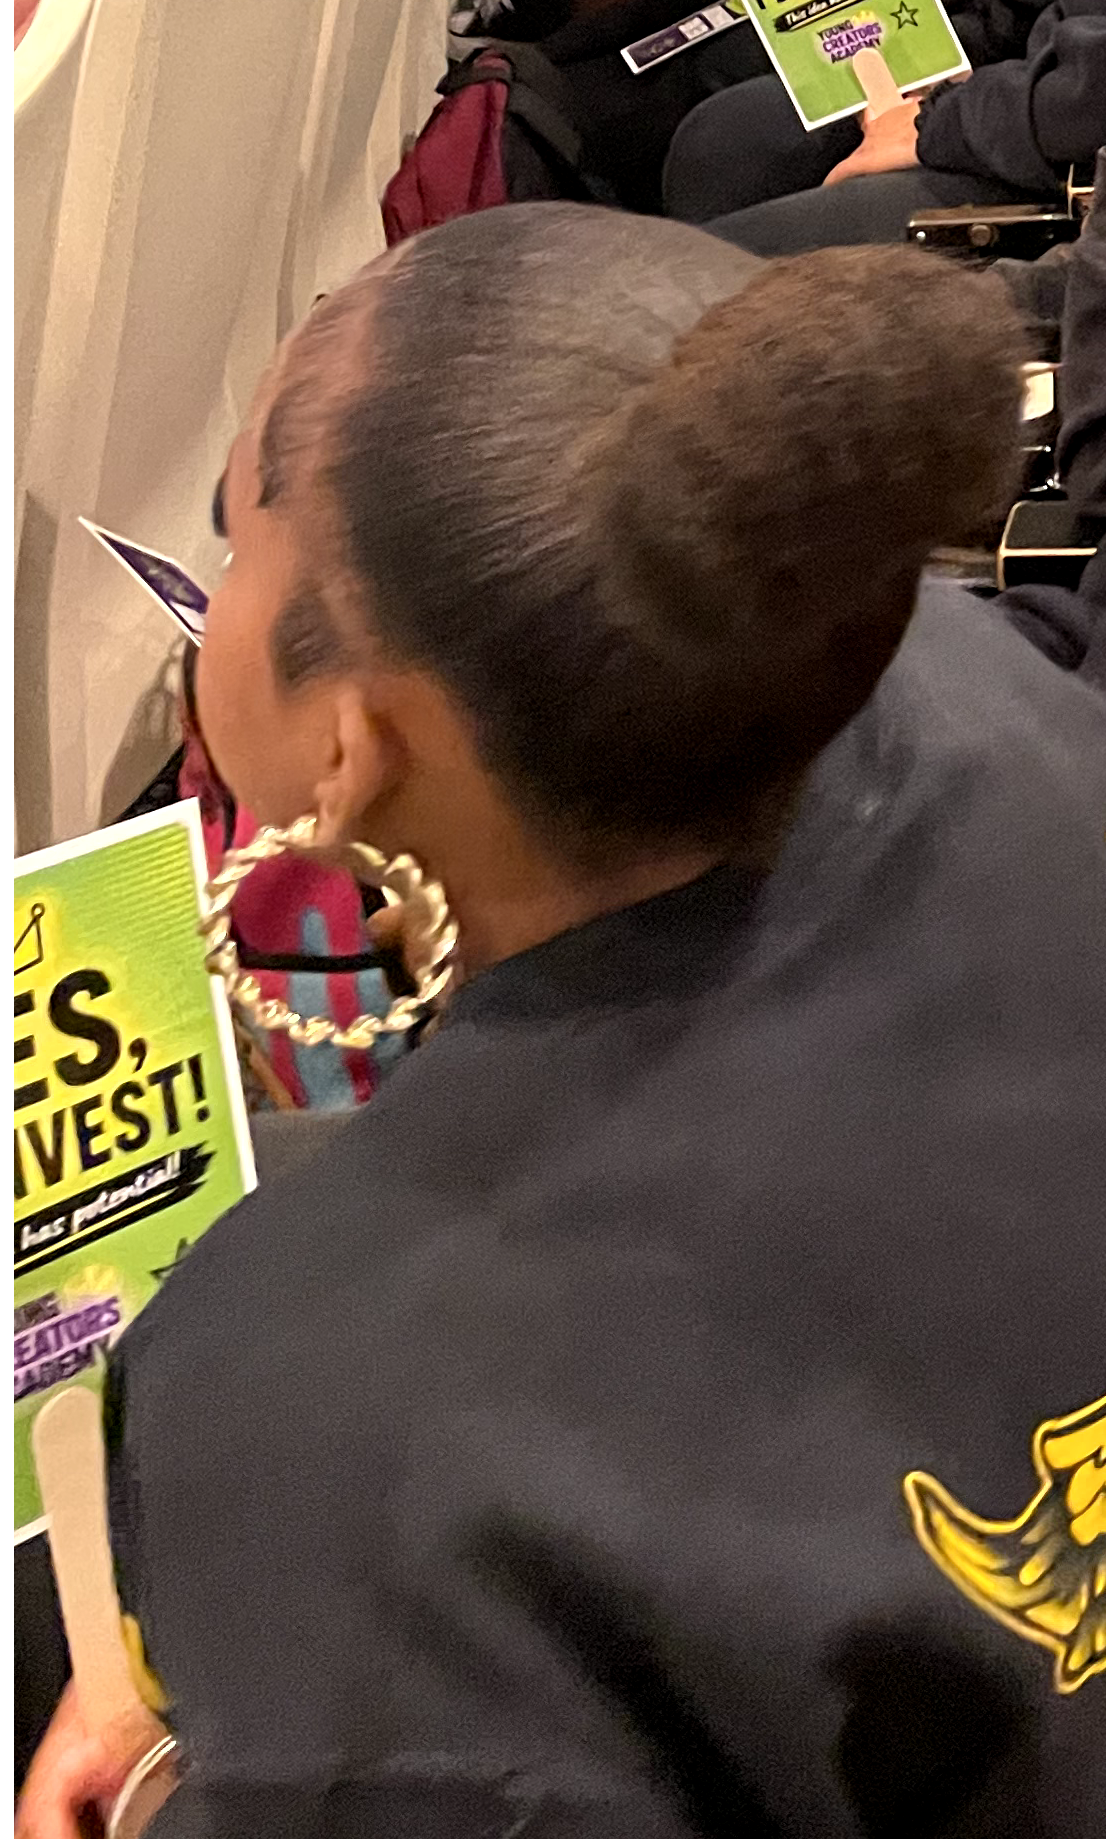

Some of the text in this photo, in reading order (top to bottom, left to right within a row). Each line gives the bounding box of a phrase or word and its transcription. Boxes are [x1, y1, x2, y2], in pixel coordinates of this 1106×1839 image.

[817, 19, 854, 41] YOUNG
[822, 22, 882, 53] CREATORS
[20, 1150, 181, 1251] has potential!
